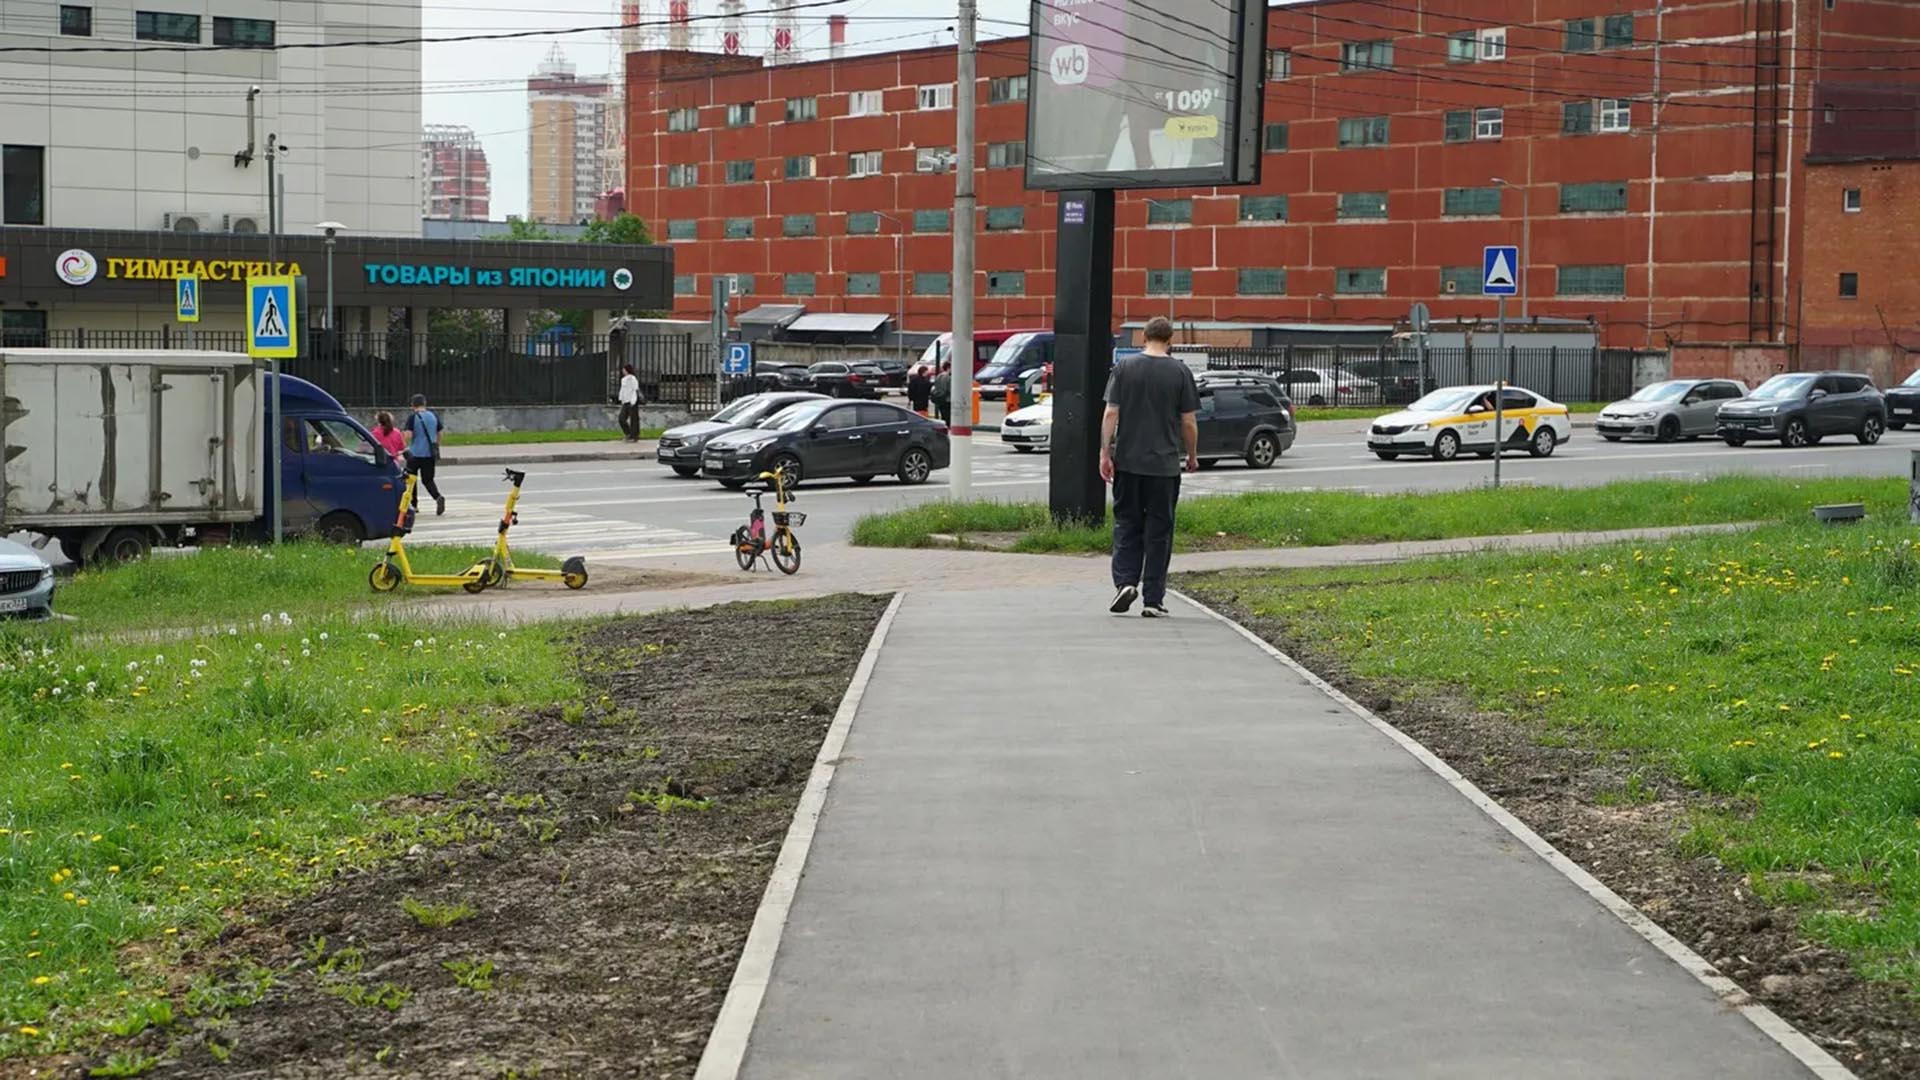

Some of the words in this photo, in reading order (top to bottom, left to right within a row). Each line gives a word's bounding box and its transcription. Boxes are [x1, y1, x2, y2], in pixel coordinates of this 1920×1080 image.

[1054, 12, 1081, 27] вкус
[1056, 48, 1085, 76] wb
[106, 258, 302, 280] ГИМНАСТИКА
[365, 264, 471, 286] ТОВАРЫ
[476, 270, 501, 285] из
[509, 268, 606, 288] ЯПОНИИ
